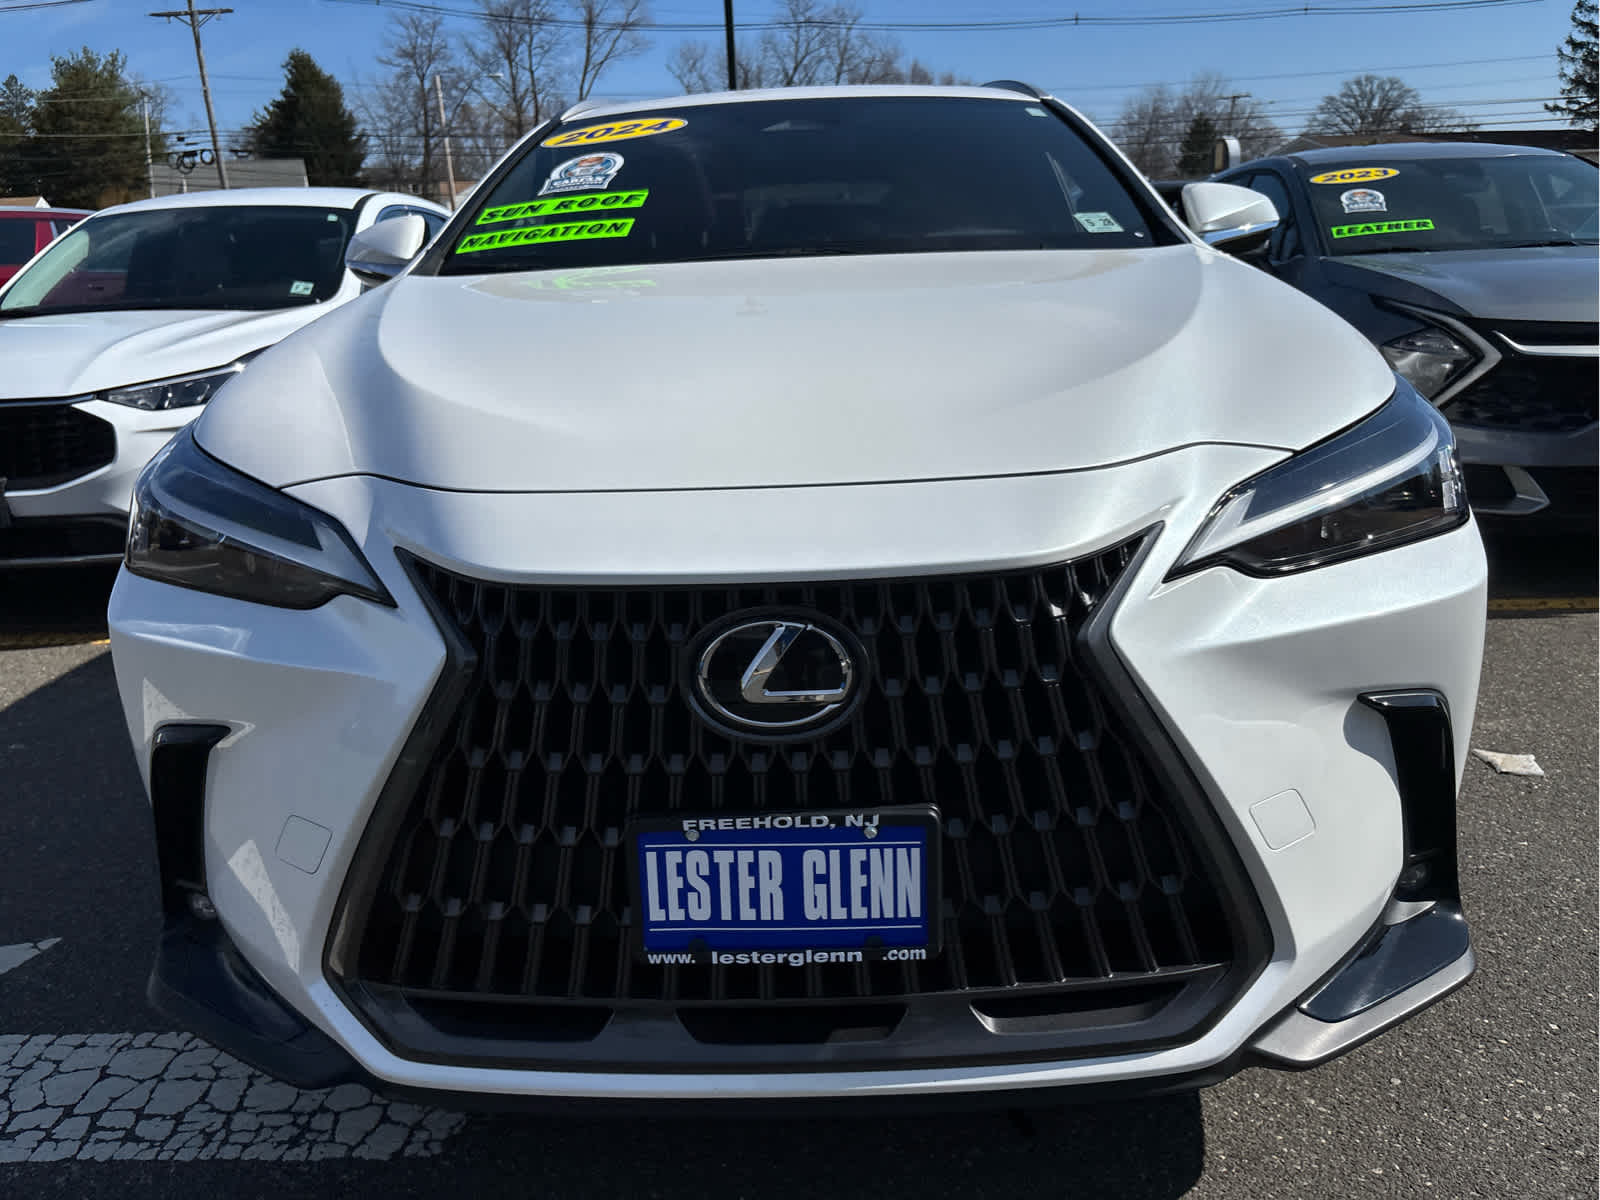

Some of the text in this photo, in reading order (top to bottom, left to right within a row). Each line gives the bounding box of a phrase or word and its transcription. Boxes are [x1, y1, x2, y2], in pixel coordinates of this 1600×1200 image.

[558, 119, 671, 145] 2024
[1321, 169, 1389, 182] 2023
[481, 193, 645, 222] SUN ROOF
[462, 221, 627, 250] NAVIGATION
[1335, 220, 1430, 237] LEATHER
[682, 813, 880, 832] FREEHOLD, NJ
[645, 847, 922, 922] LESTER GLENN
[647, 948, 927, 966] www. lesterglenn .com
